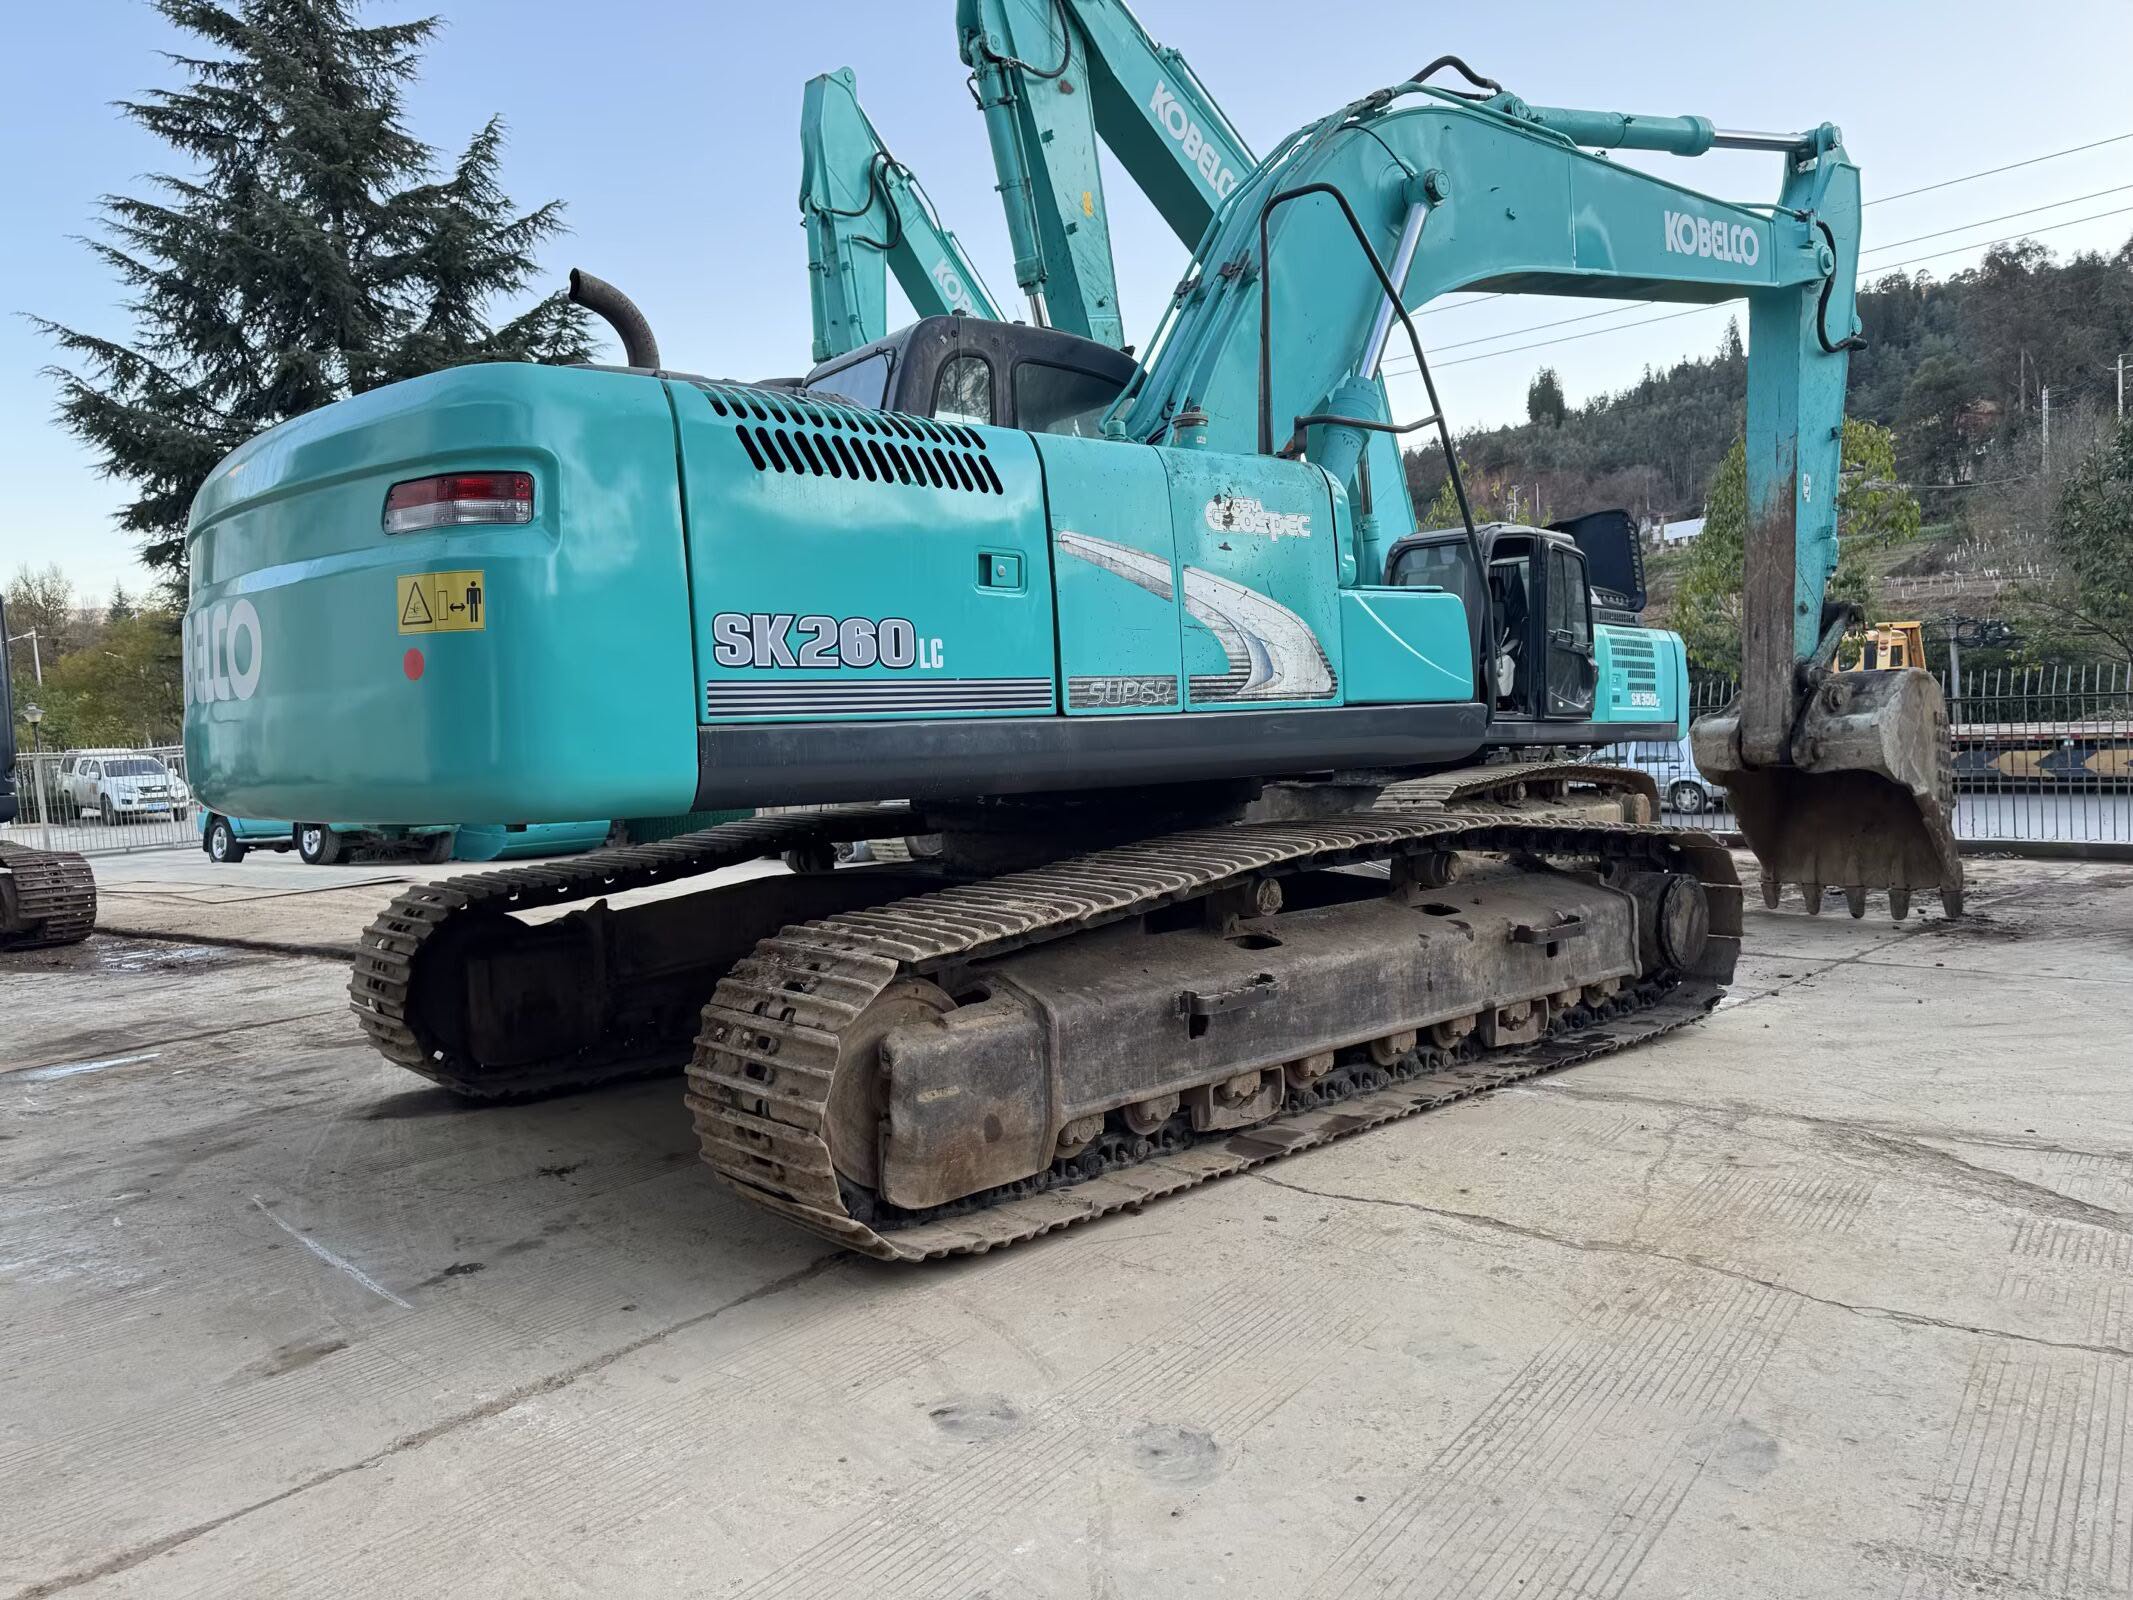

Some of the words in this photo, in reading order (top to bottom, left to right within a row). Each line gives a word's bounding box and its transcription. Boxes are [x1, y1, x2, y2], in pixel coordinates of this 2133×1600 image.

[1149, 79, 1239, 201] KOBELC
[1664, 210, 1759, 266] KOBELCO
[932, 256, 980, 318] KOB
[184, 598, 262, 706] BELCO
[712, 611, 916, 669] SK260
